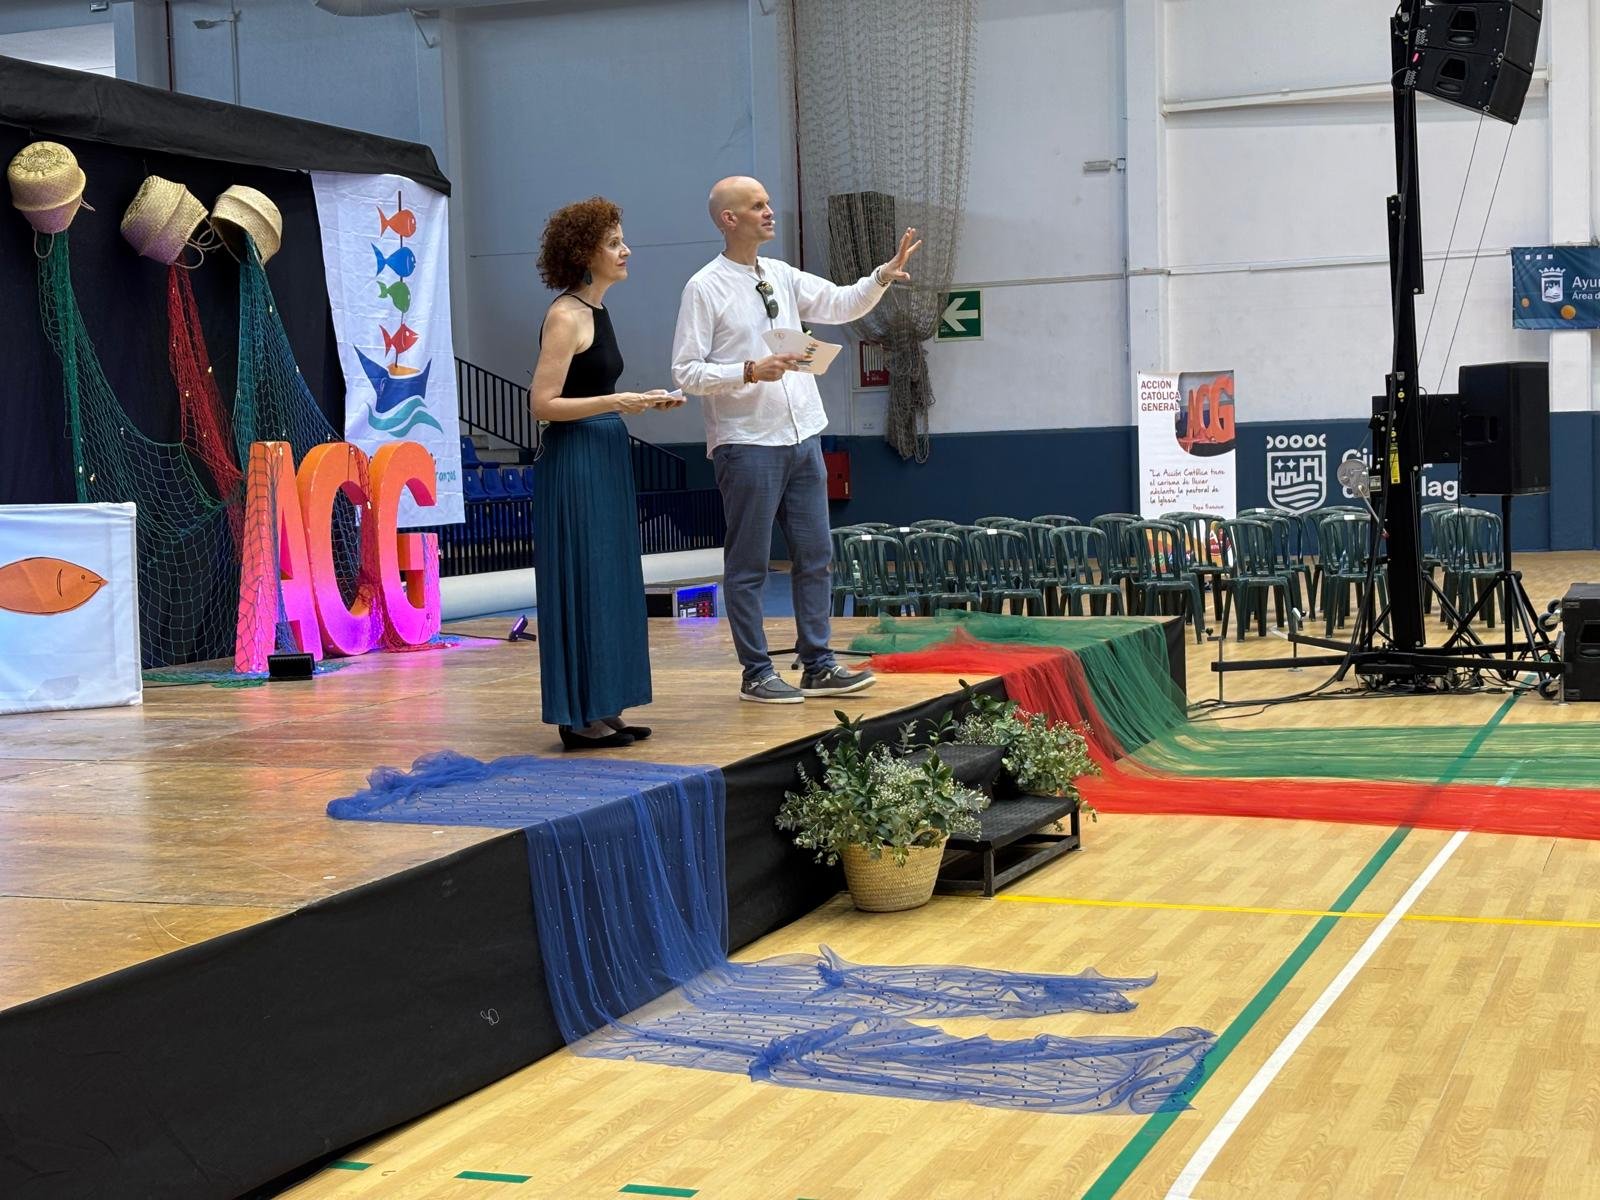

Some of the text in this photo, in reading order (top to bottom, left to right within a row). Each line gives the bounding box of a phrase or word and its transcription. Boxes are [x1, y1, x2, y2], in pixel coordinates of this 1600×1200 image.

[1141, 402, 1180, 412] GENERAL
[1421, 475, 1459, 501] lag
[234, 440, 442, 674] ACG
